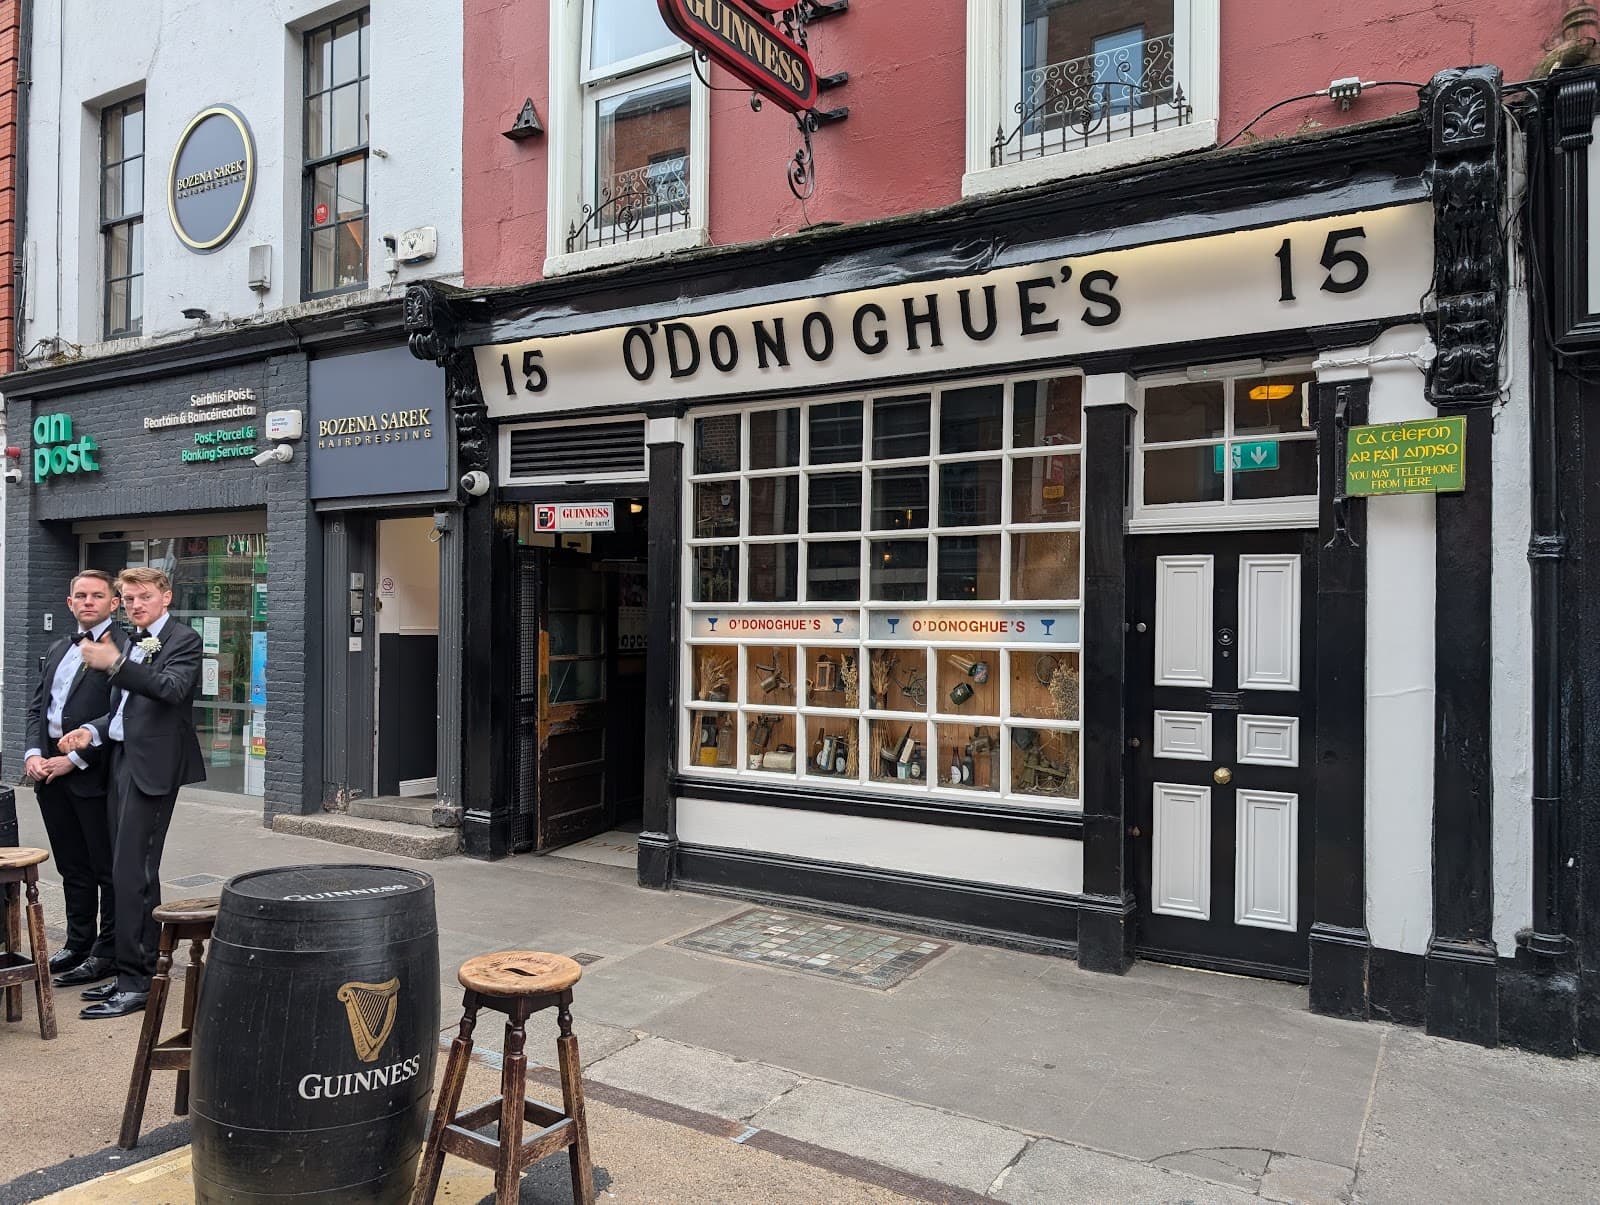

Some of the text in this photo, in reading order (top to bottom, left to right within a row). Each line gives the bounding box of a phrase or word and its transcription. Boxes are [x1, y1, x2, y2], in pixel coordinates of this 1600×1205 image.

[687, 0, 805, 91] GUINNESS
[177, 160, 244, 191] BOZENA SAREK
[1275, 225, 1367, 304] 15
[622, 266, 1121, 381] O'DONOGHUE'S
[500, 350, 548, 396] 15
[179, 411, 187, 425] &
[319, 407, 431, 437] BOZENA SAREK
[34, 413, 73, 445] an
[216, 428, 245, 442] Parcel
[245, 425, 256, 438] &
[318, 428, 432, 449] HAIRDRESSING
[34, 435, 99, 484] post
[181, 444, 256, 462] Banking Services
[1349, 463, 1458, 481] YOU MAY TELEPHONE
[1371, 476, 1433, 490] FROM HERE
[562, 508, 609, 519] GUINNESS
[728, 619, 821, 631] O'DONOGHUE'S
[912, 619, 1026, 633] O'DONOGHUE'S
[283, 884, 409, 901] GUINNESS
[298, 1053, 421, 1100] GUINNESS
